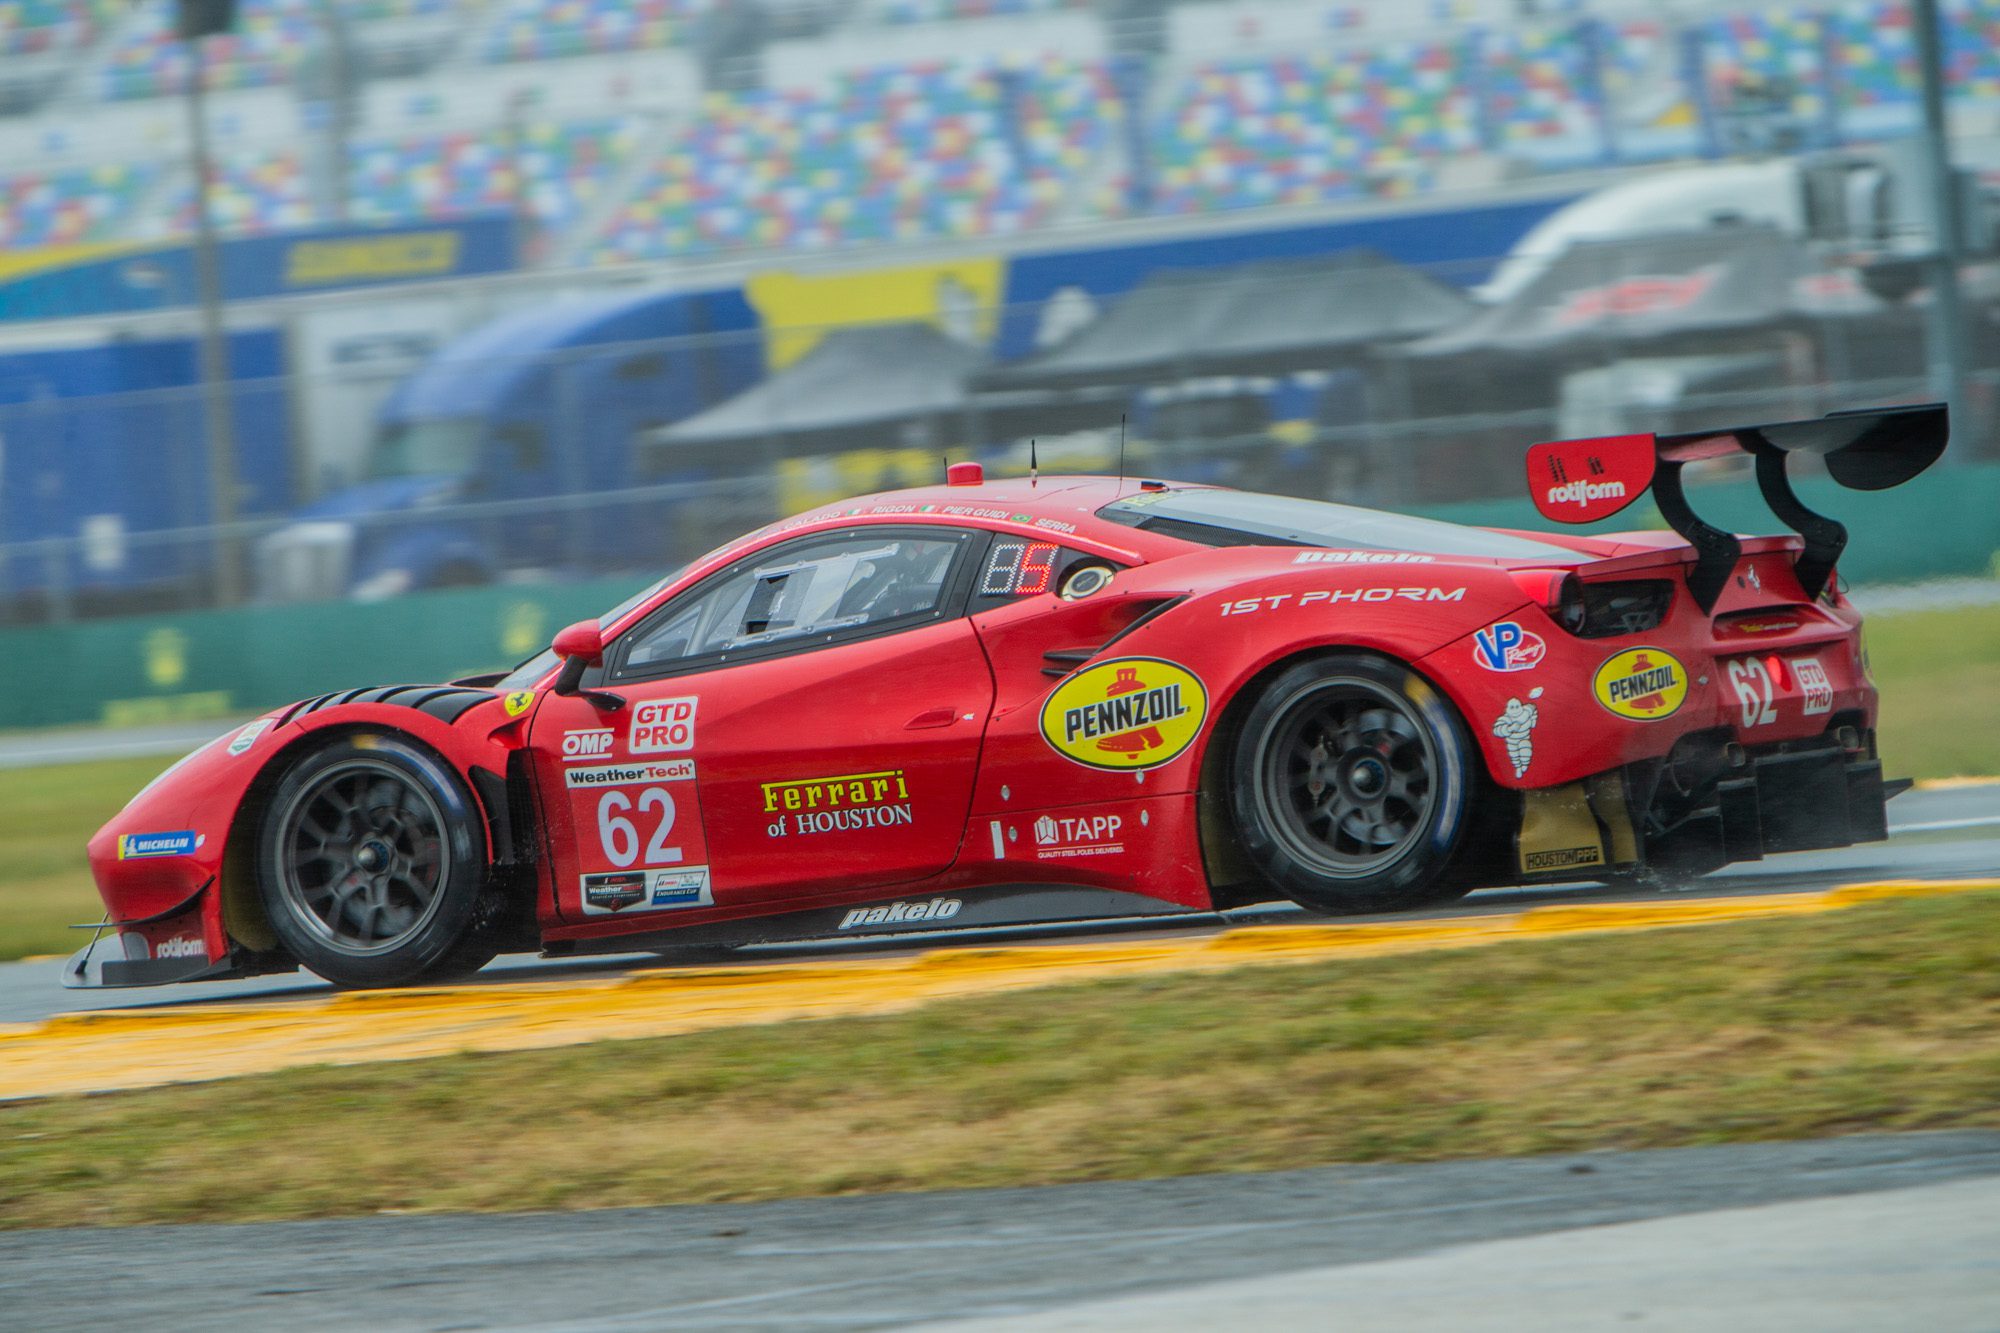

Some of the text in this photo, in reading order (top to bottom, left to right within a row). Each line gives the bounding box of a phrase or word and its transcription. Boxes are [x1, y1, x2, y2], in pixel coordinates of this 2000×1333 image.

[1548, 480, 1625, 507] rotiform
[871, 504, 917, 514] RIGON
[943, 504, 975, 516] PIER
[973, 508, 1010, 519] GUIDI
[1034, 518, 1077, 534] SERRA
[1220, 587, 1467, 616] 1ST PHORM
[1474, 622, 1524, 669] VP
[1609, 664, 1677, 703] PENNZOIL
[1797, 663, 1826, 685] GTD
[1728, 656, 1778, 729] 62
[1804, 687, 1831, 709] PRO
[637, 703, 692, 724] GTD
[1065, 683, 1187, 742] PENNZOIL
[562, 733, 614, 755] OMP
[634, 724, 689, 748] PRO
[761, 770, 909, 812] Ferrari
[597, 787, 684, 868] 62
[767, 803, 913, 837] of HOUSTON
[1059, 815, 1122, 841] TAPP
[138, 837, 190, 851] MICHELIN
[1528, 850, 1575, 869] HOUSTON
[838, 897, 963, 930] pakelo
[157, 936, 206, 958] rotiform
